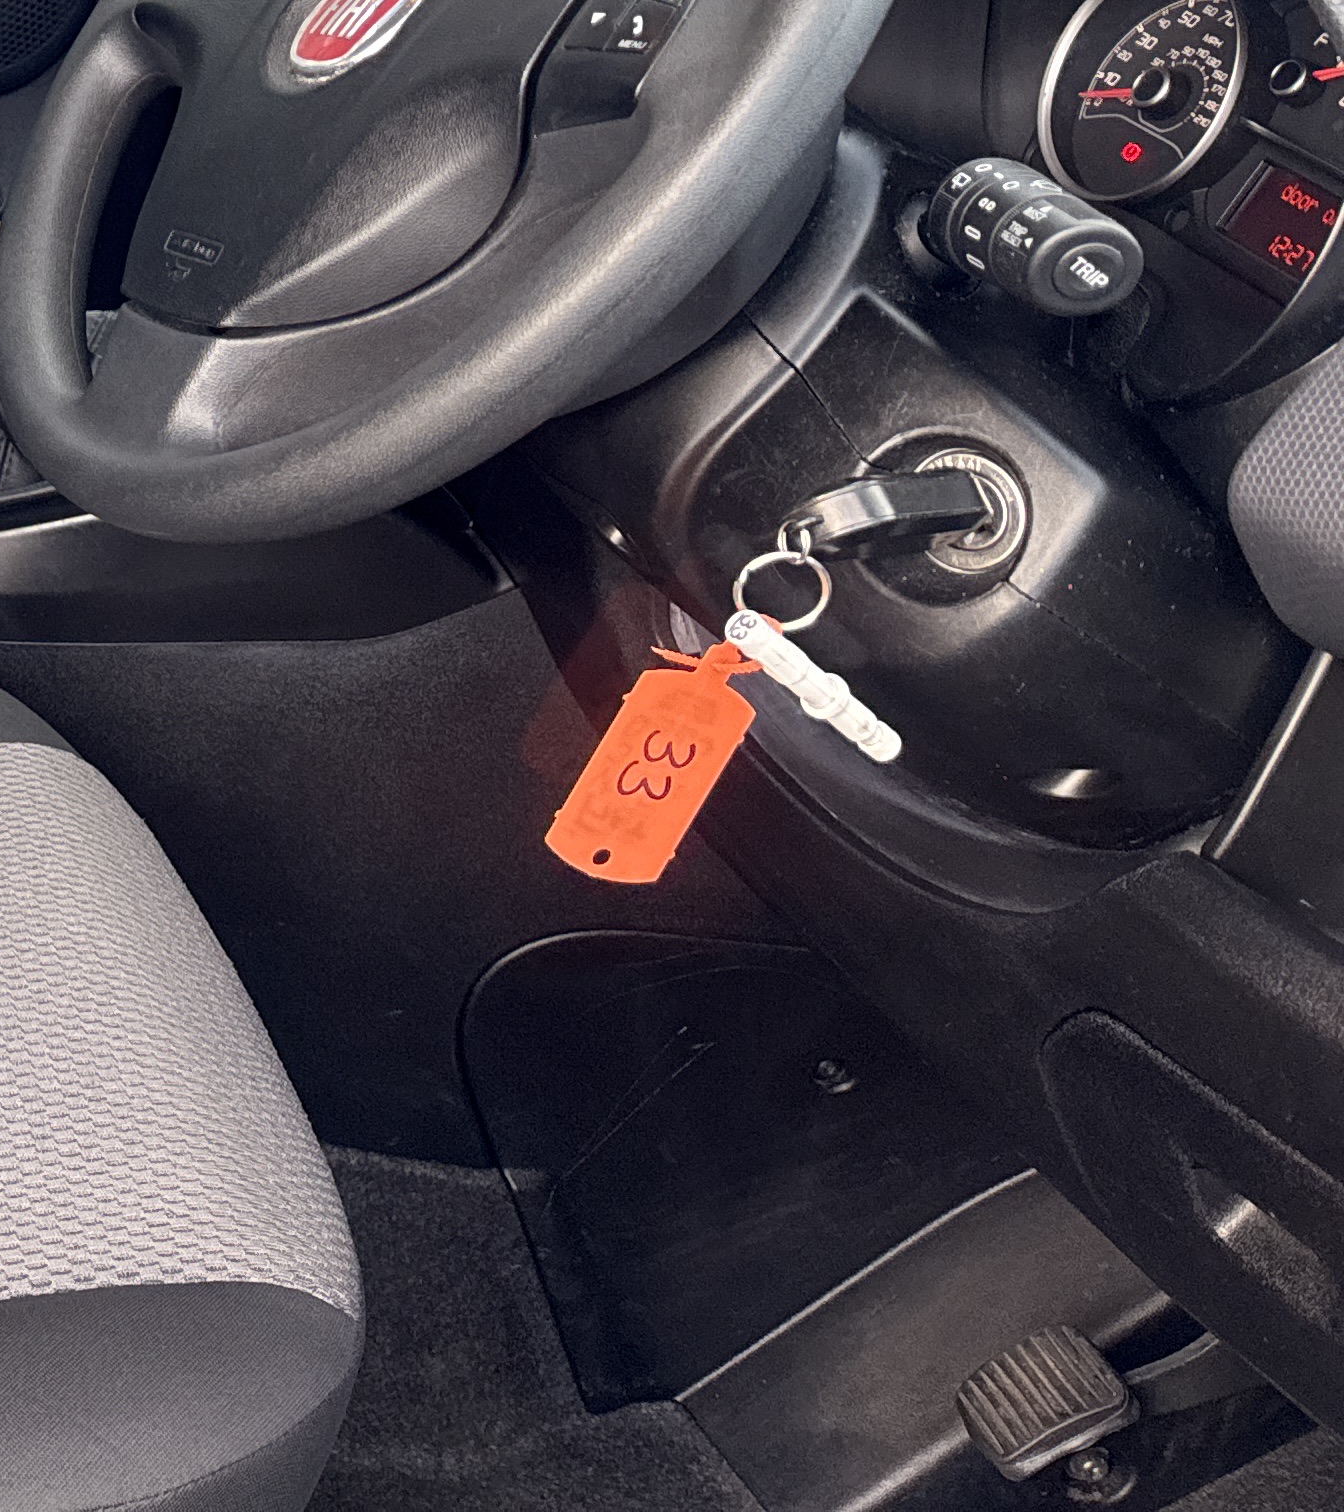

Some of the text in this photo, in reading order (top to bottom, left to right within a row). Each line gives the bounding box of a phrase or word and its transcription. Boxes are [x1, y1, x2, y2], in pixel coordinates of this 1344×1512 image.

[1176, 9, 1201, 29] 50
[617, 38, 649, 50] MENU
[1134, 31, 1159, 51] 30
[1103, 71, 1122, 87] 10
[1268, 235, 1315, 272] 12:27
[1069, 255, 1110, 287] TRIP
[617, 729, 696, 800] 33
